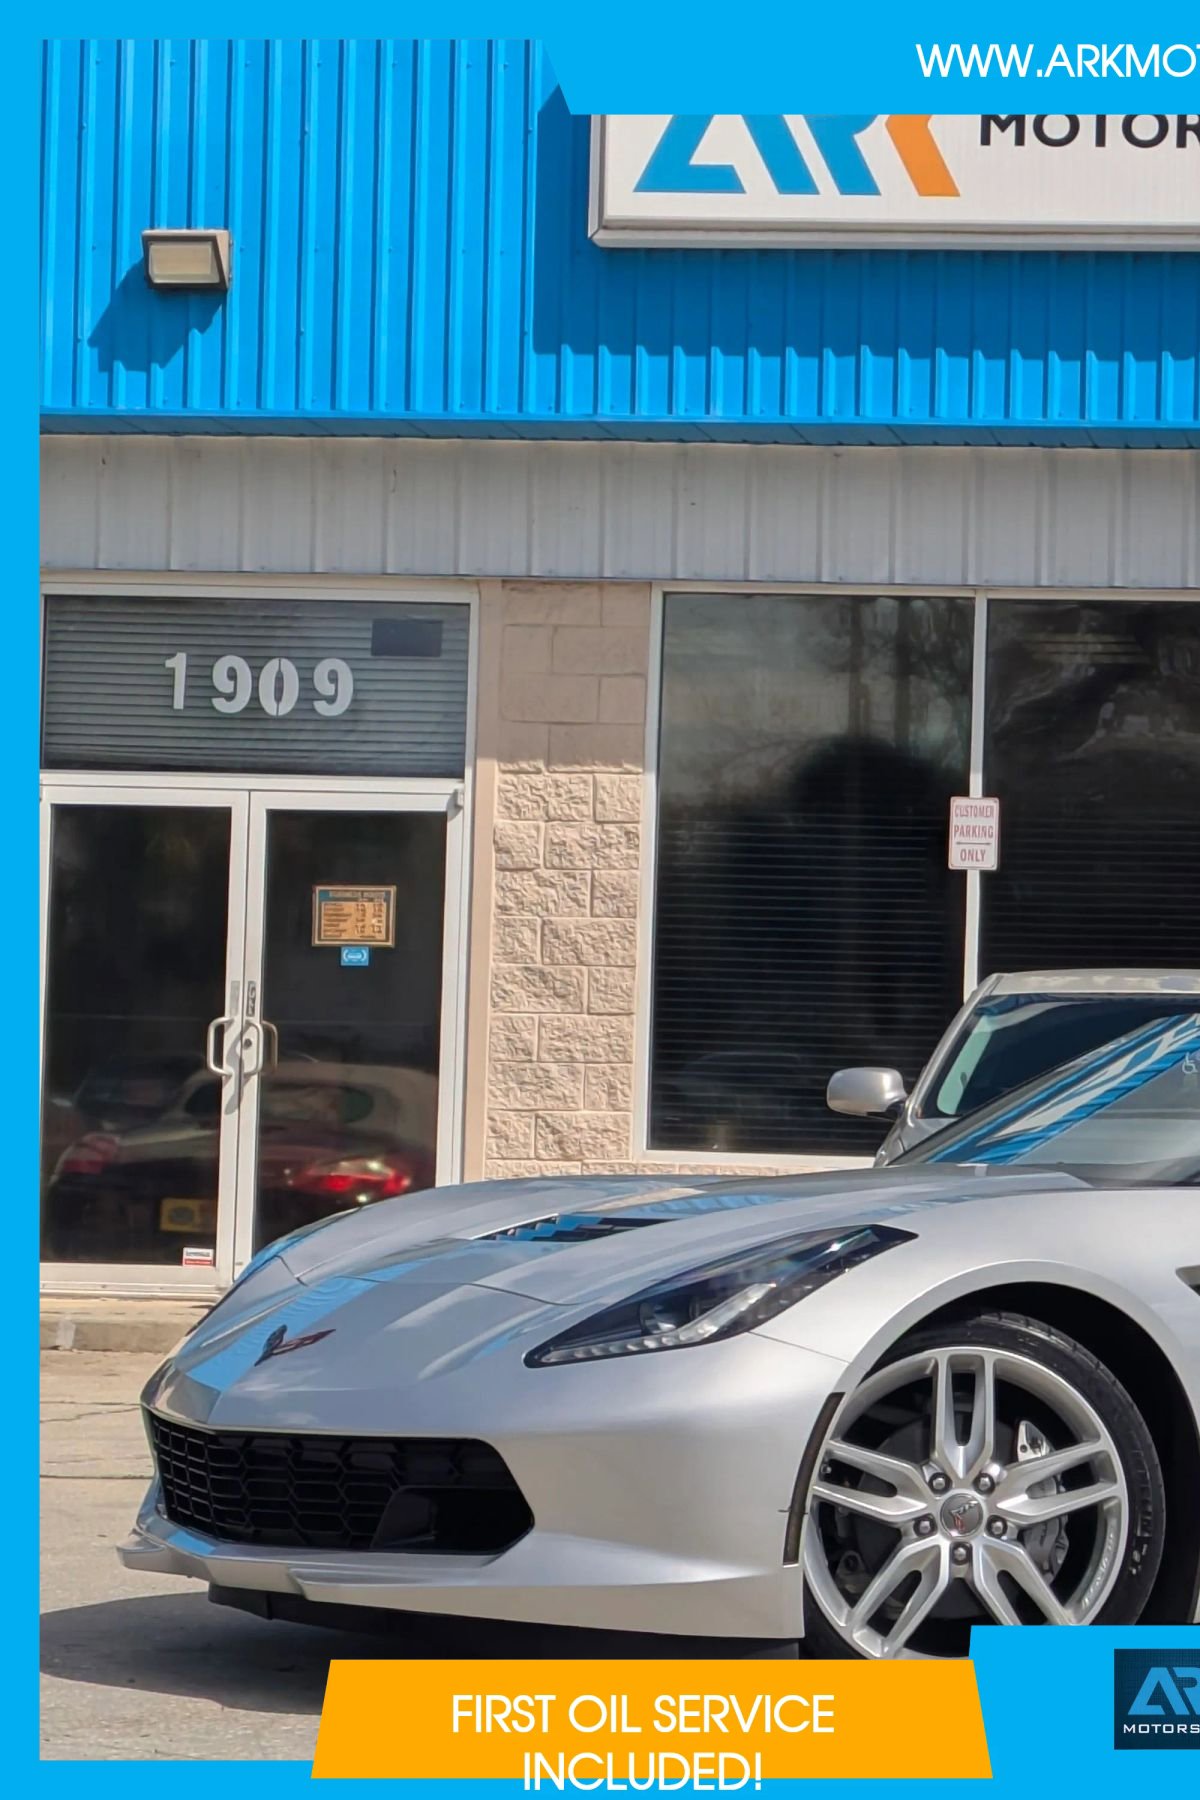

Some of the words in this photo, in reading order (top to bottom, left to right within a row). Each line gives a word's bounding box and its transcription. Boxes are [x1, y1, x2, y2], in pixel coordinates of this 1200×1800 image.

[164, 651, 354, 717] 1909
[954, 804, 994, 818] CUSTOMER
[953, 824, 994, 839] PARKING
[959, 848, 986, 862] ONLY
